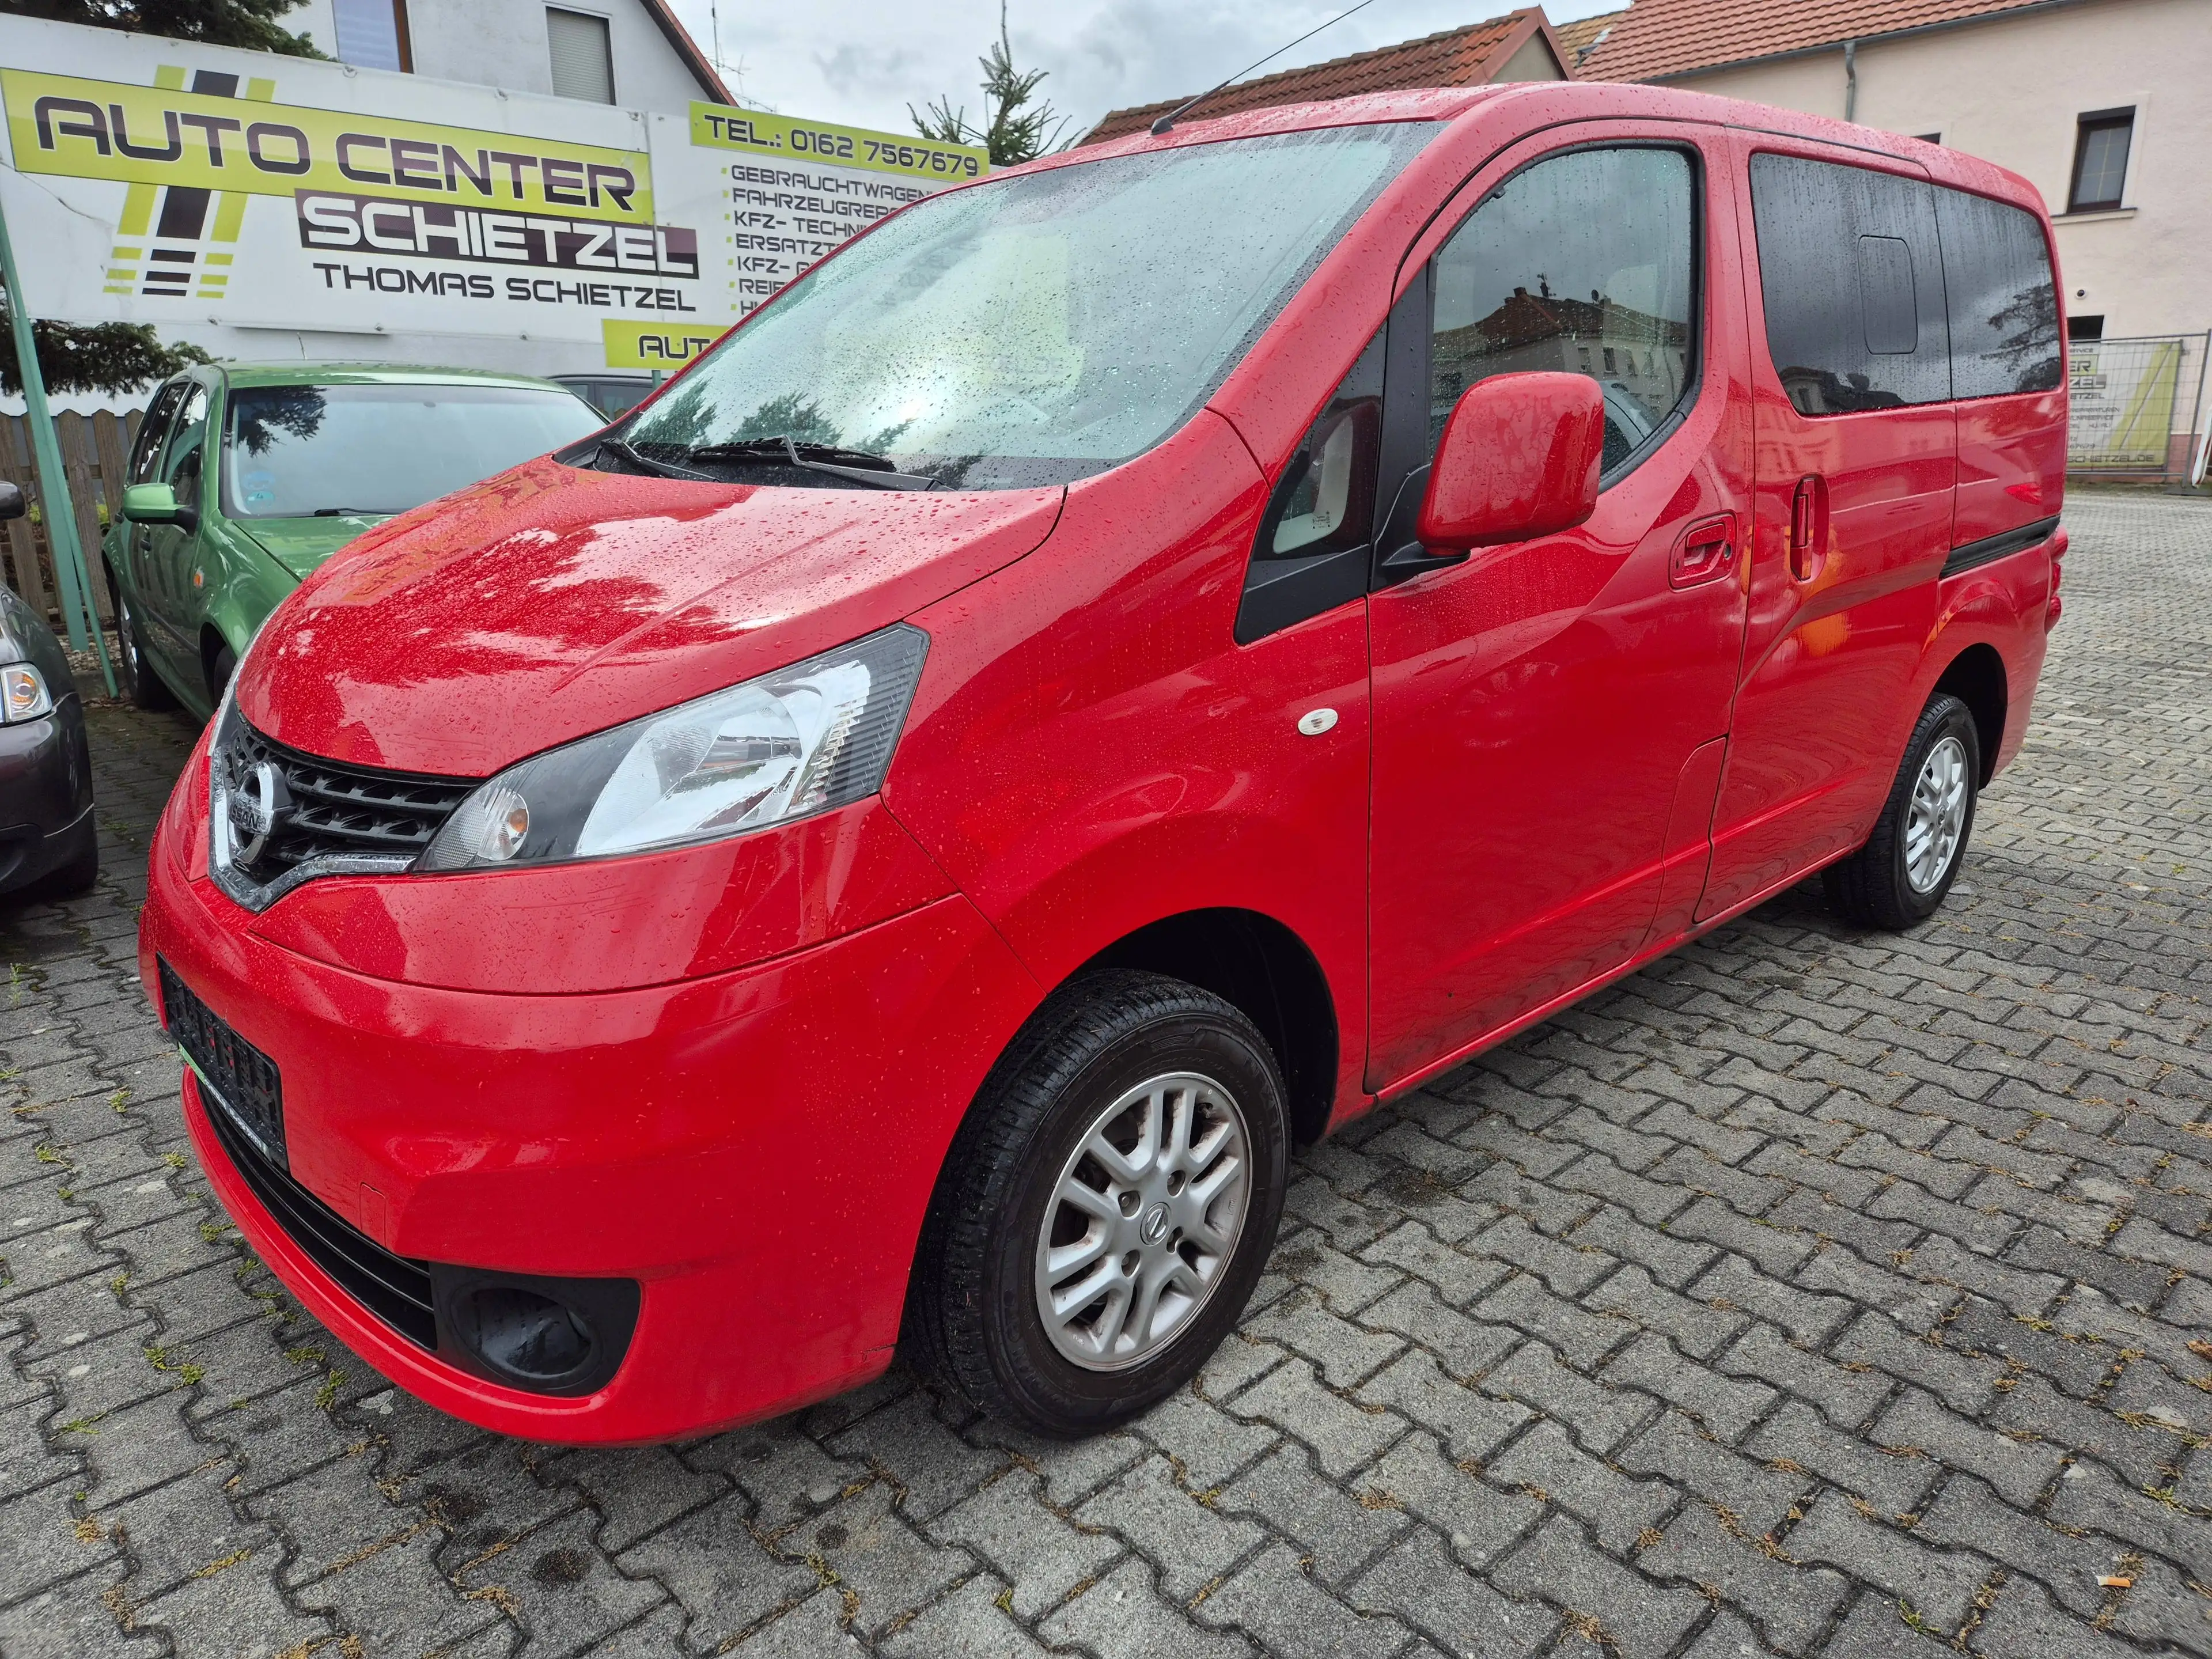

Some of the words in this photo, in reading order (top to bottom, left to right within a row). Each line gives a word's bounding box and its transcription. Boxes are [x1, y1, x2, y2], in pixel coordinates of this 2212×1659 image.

[35, 96, 310, 175] AUTO
[336, 133, 635, 211] CENTER
[704, 115, 782, 148] TEL.:
[791, 129, 853, 158] 0162
[863, 141, 978, 177] 7567679
[732, 165, 932, 202] GEBRAUCHTWAGEN
[734, 211, 787, 230] KFZ-
[303, 196, 692, 275] SCHIETZEL
[736, 233, 839, 256] ERSATZT
[737, 256, 790, 274] KFZ-
[313, 263, 494, 298] THOMAS
[506, 278, 695, 312] SCHIETZEL
[739, 278, 787, 294] REIF
[639, 335, 710, 359] AUT
[2069, 361, 2091, 372] ER
[2069, 376, 2105, 388] ZEL
